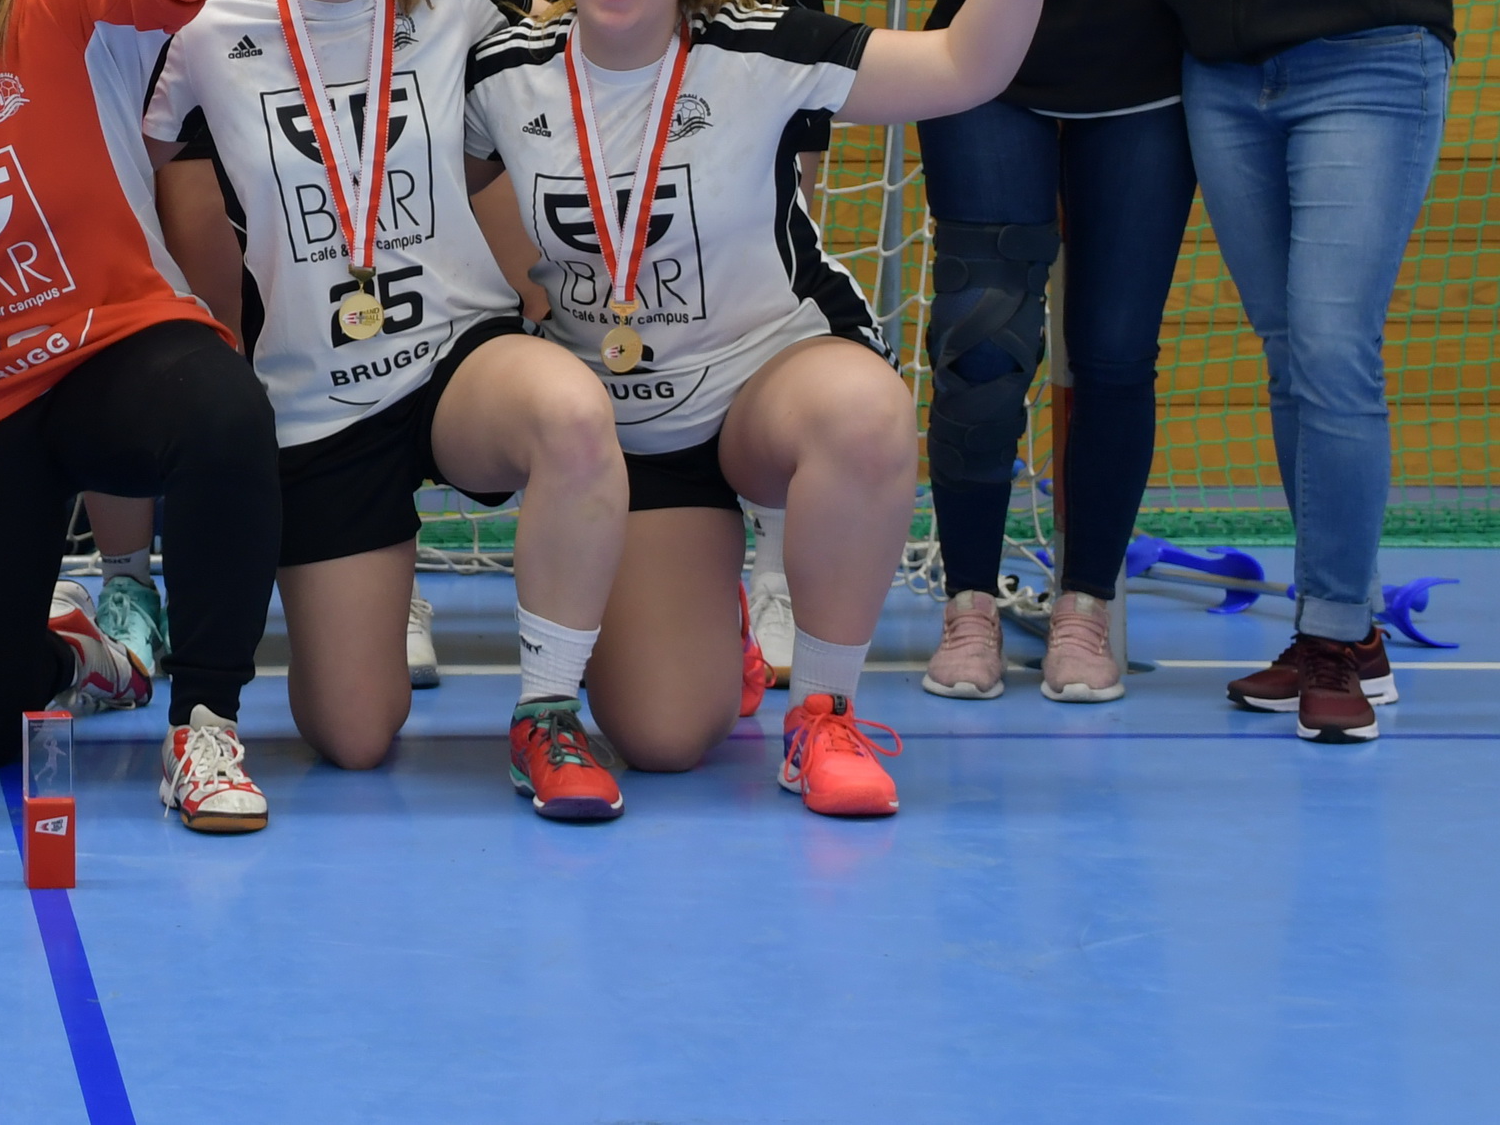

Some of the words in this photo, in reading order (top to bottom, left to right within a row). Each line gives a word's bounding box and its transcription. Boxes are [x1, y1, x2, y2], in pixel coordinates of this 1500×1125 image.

[228, 48, 263, 60] adidas
[522, 125, 552, 137] adidas
[310, 246, 337, 262] café
[376, 234, 423, 251] campus
[8, 288, 60, 313] campus
[330, 265, 424, 348] 25
[572, 308, 595, 323] café
[599, 312, 608, 324] &
[637, 312, 689, 326] campus
[330, 341, 430, 387] BRUGG
